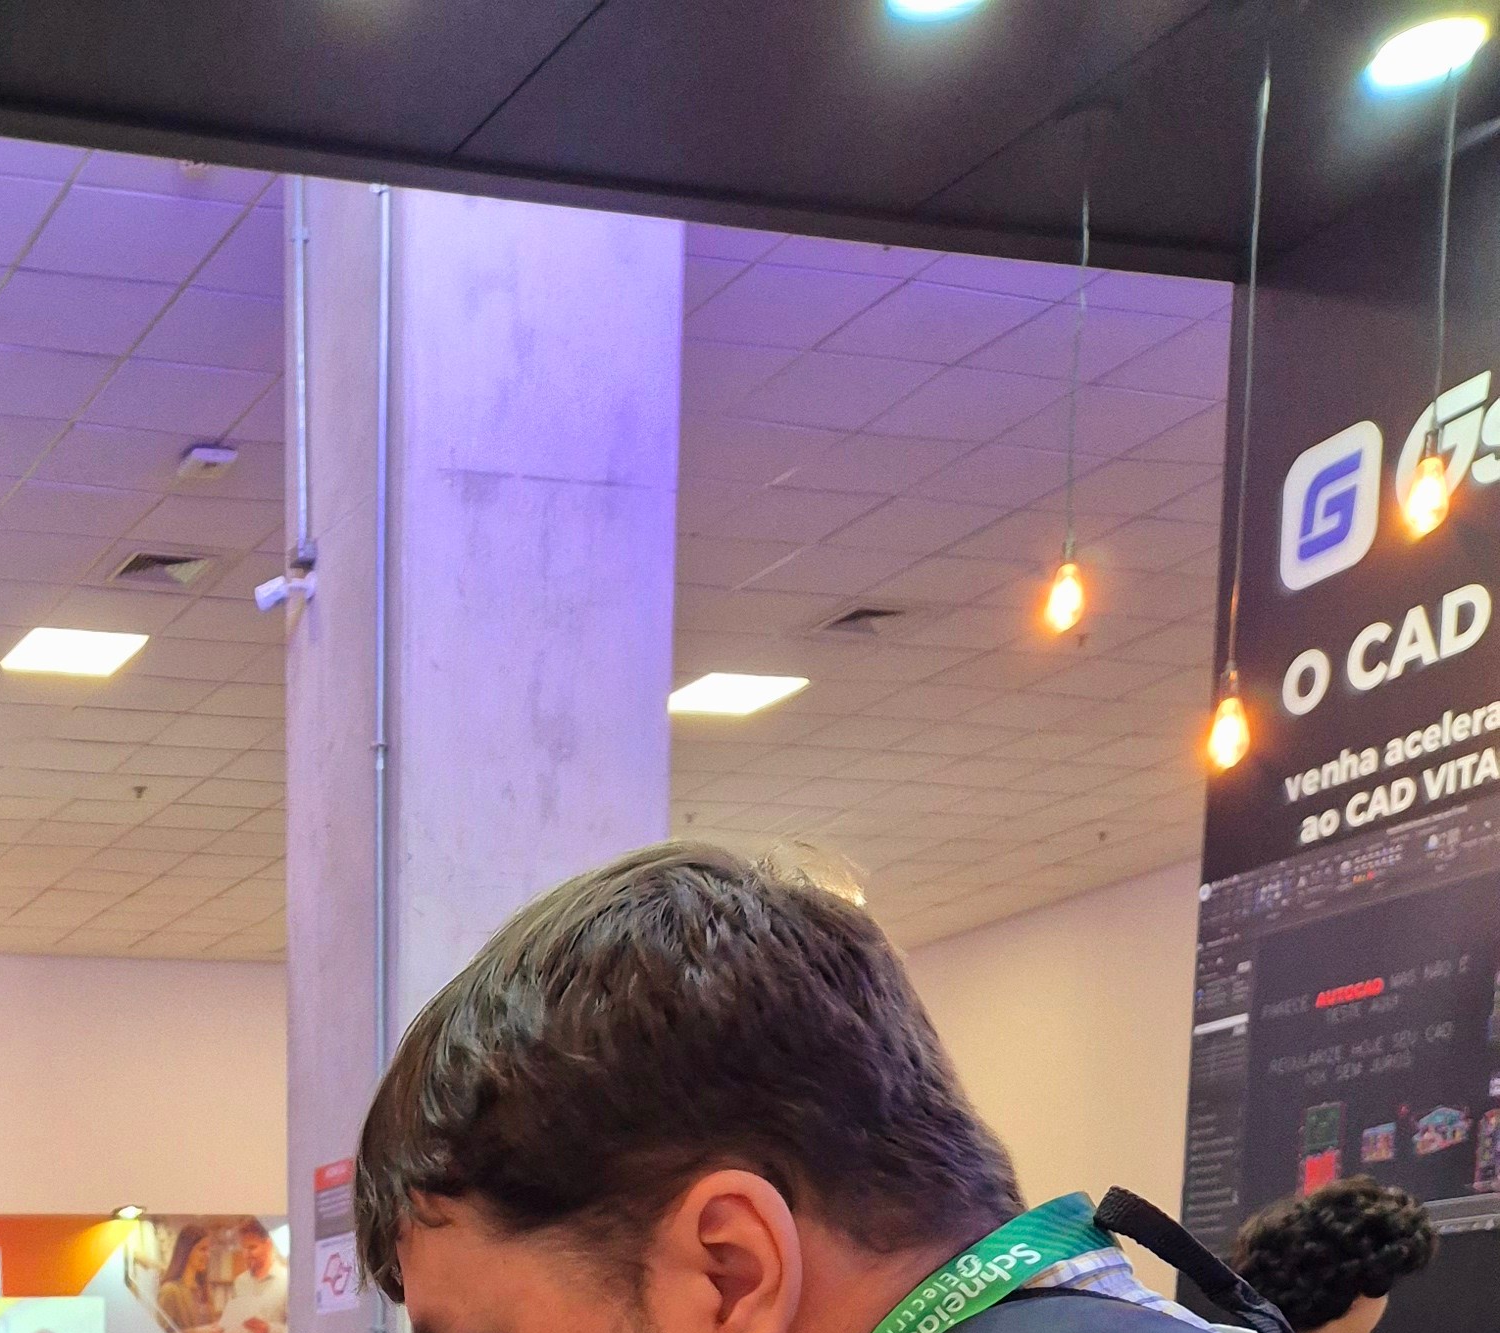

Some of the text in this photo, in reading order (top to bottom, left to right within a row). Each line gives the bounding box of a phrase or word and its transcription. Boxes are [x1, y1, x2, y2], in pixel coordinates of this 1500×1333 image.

[1282, 583, 1491, 715] O CAD
[1285, 700, 1500, 802] venha acelera
[1300, 810, 1338, 844] ao
[1345, 777, 1417, 829] CAD
[1422, 747, 1500, 800] VITA
